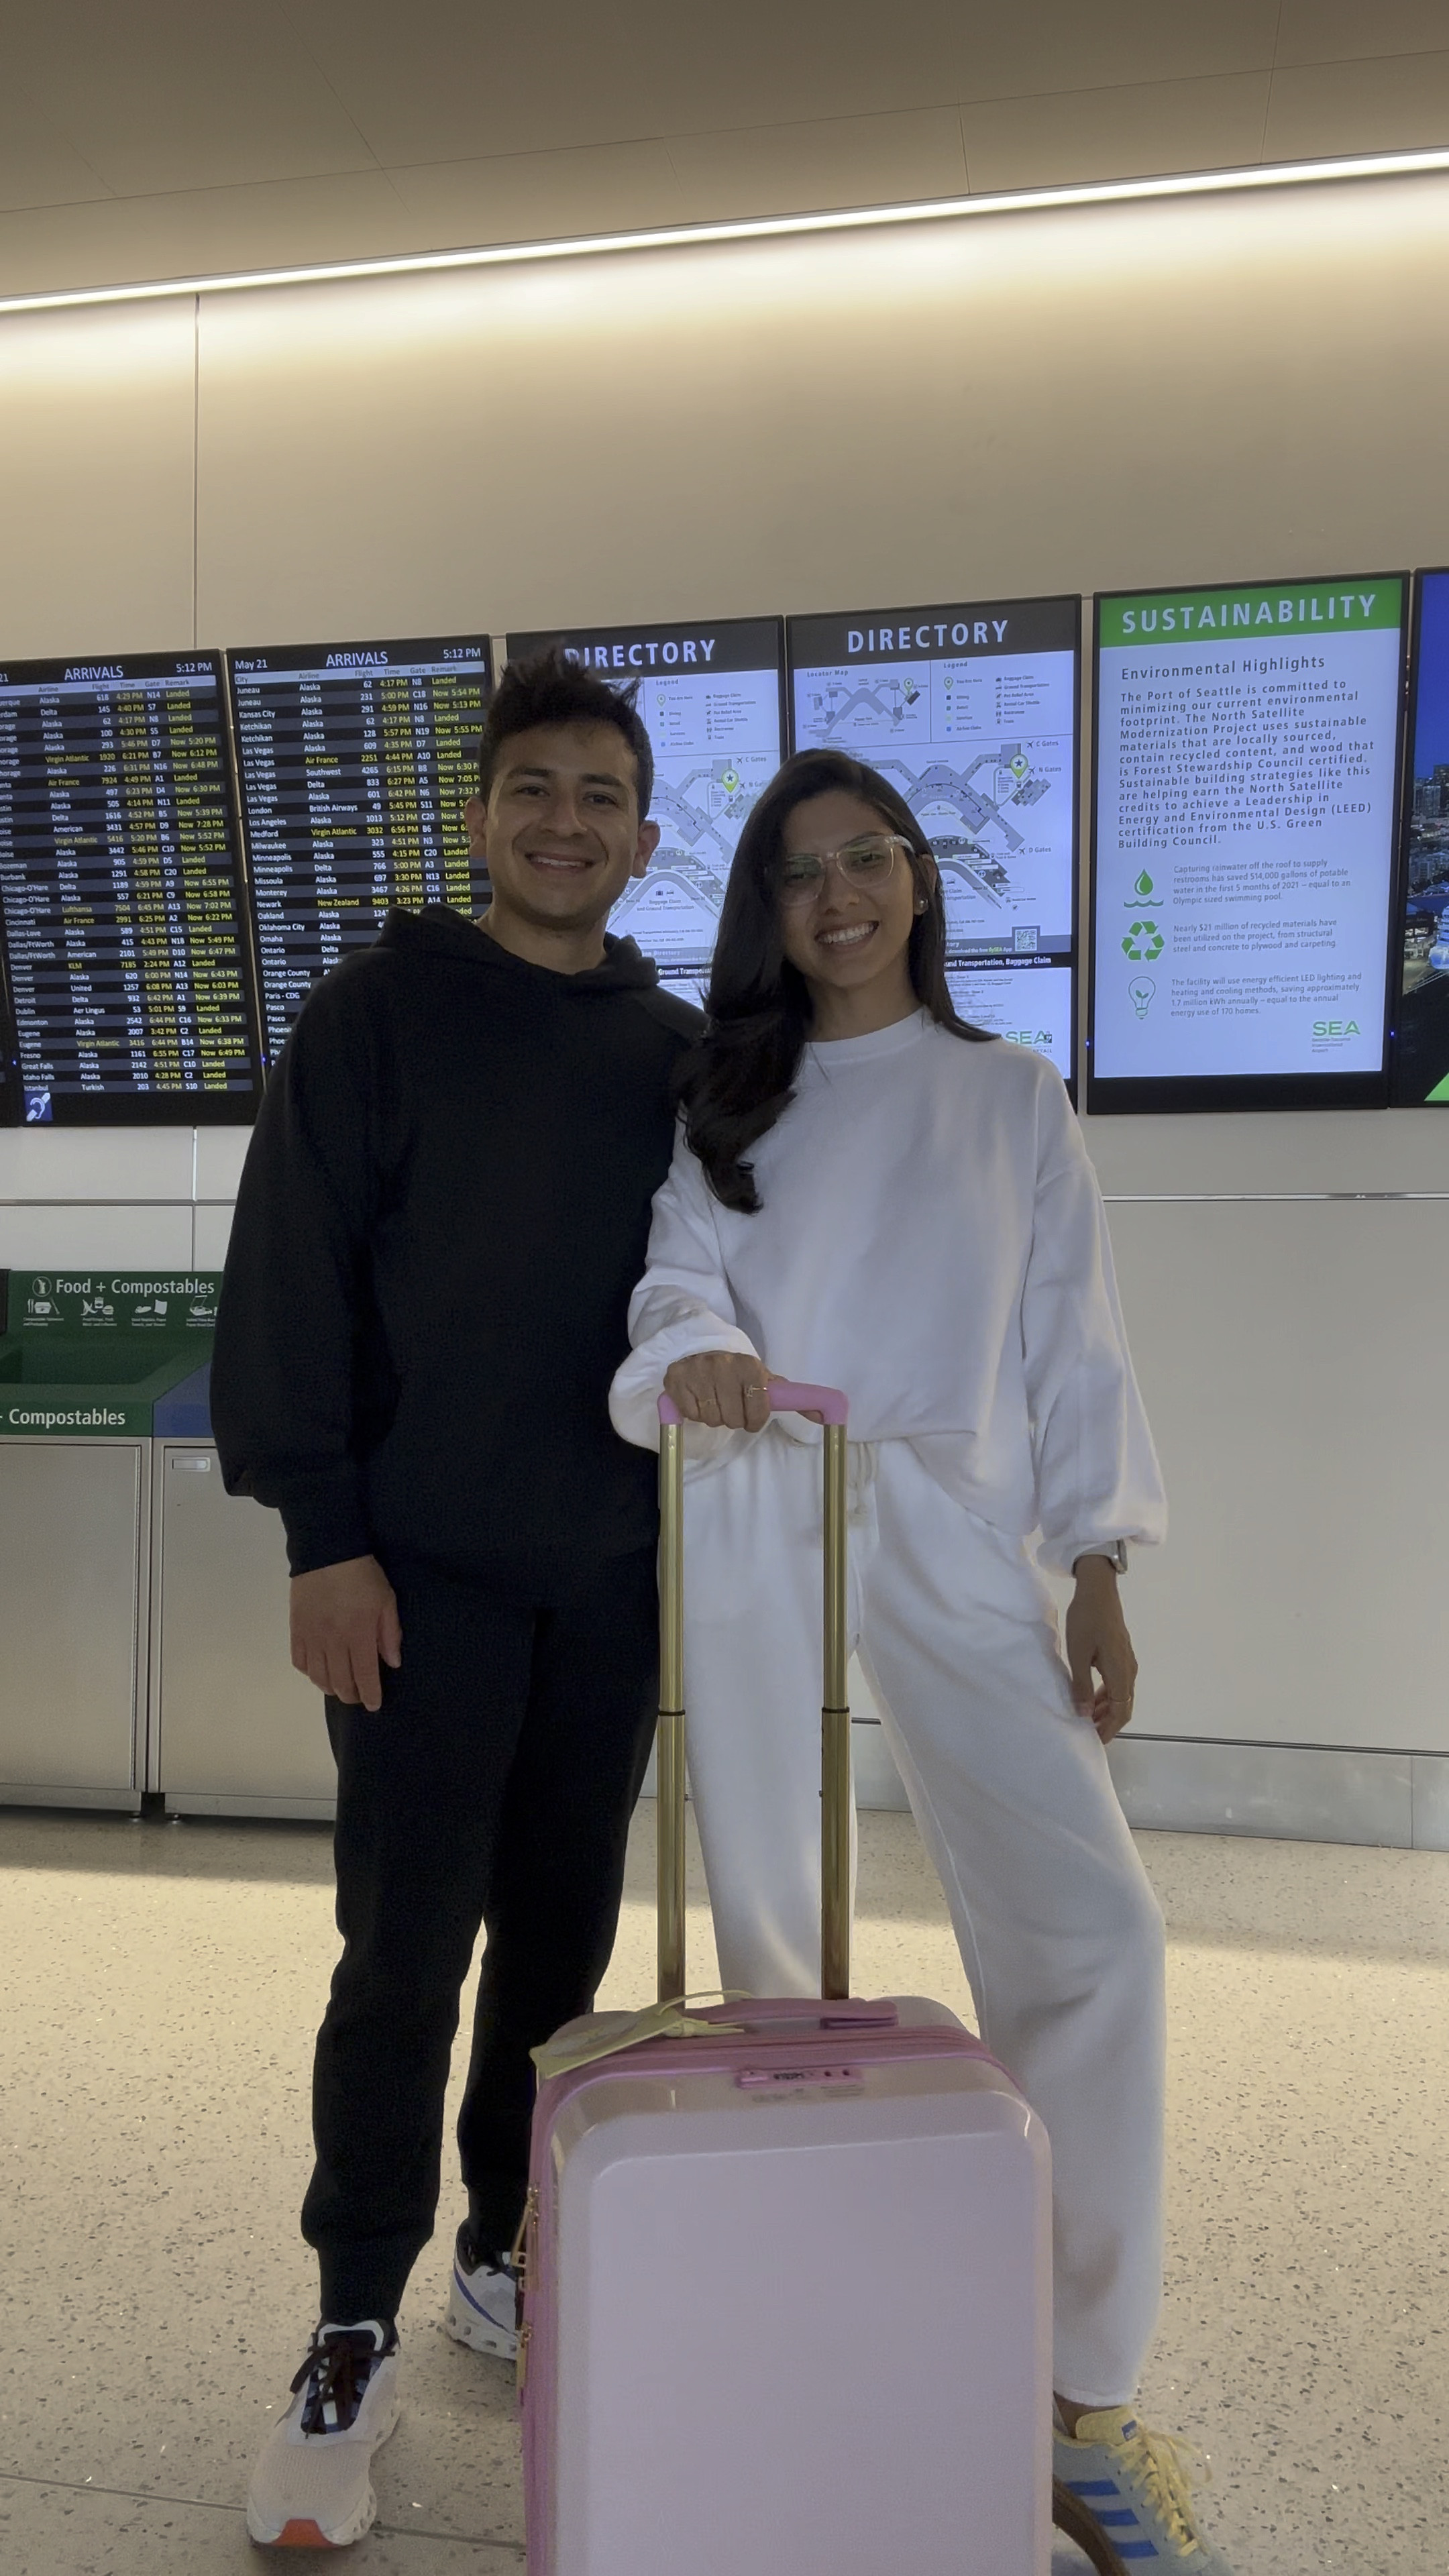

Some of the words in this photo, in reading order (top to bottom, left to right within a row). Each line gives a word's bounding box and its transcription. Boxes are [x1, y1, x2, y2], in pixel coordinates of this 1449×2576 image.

[1122, 594, 1376, 633] SUSTAINABILITY
[848, 620, 1009, 653] DIRECTORY
[235, 660, 254, 670] May
[256, 659, 267, 668] 21
[326, 651, 388, 667] ARRIVALS
[443, 648, 463, 659] 5:12
[466, 647, 480, 657] PM
[565, 639, 715, 668] DIRECTORY
[64, 665, 123, 680] ARRIVALS
[176, 662, 195, 673] 5:12
[197, 661, 212, 671] PM
[835, 669, 849, 677] Map
[944, 661, 968, 669] Legend
[1122, 660, 1235, 680] Environmental
[1242, 655, 1324, 674] Highlights
[234, 675, 248, 684] City
[354, 669, 373, 678] Flight
[1120, 692, 1141, 702] The
[1147, 691, 1173, 700] Port
[1178, 688, 1190, 698] of
[1196, 685, 1241, 697] Seattle
[1247, 684, 1256, 694] is
[1262, 680, 1328, 693] committed
[1334, 680, 1346, 688] to
[262, 710, 275, 718] City
[382, 703, 396, 712] 4:59
[398, 703, 409, 711] PM
[414, 702, 427, 710] N16
[433, 702, 448, 710] Now
[453, 700, 468, 708] 5:13
[1120, 702, 1186, 714] minimizing
[1191, 702, 1212, 710] our
[1216, 698, 1261, 708] current
[1267, 690, 1358, 705] environmental
[1120, 715, 1179, 727] footprint.
[1185, 713, 1205, 722] The
[1212, 710, 1245, 721] North
[1251, 707, 1304, 718] Satellite
[1120, 726, 1208, 739] Modernization
[1214, 722, 1256, 735] Project
[1263, 722, 1288, 731] uses
[1294, 716, 1366, 729] sustainable
[1120, 739, 1176, 751] materials
[1182, 738, 1206, 748] that
[1212, 738, 1231, 746] are
[1236, 733, 1277, 745] locally
[1283, 730, 1335, 742] sourced,
[254, 759, 274, 767] Vegas
[401, 752, 413, 761] PM
[417, 751, 430, 759] A10
[437, 750, 462, 759] Landed
[1120, 753, 1164, 763] contain
[1170, 749, 1220, 761] recycled
[1226, 747, 1276, 758] content,
[1282, 744, 1304, 754] and
[1309, 741, 1342, 753] wood
[1348, 741, 1373, 751] that
[1120, 767, 1128, 776] is
[1134, 765, 1171, 775] Forest
[1177, 759, 1252, 773] Stewardship
[1258, 756, 1302, 768] Council
[1308, 753, 1366, 765] certified.
[1119, 775, 1189, 788] Sustainable
[1195, 773, 1244, 784] building
[1250, 769, 1313, 781] strategies
[1319, 767, 1341, 777] like
[1346, 765, 1370, 775] this
[1142, 788, 1187, 800] helping
[1193, 788, 1219, 796] earn
[1225, 785, 1244, 794] the
[1249, 782, 1284, 793] North
[1289, 780, 1342, 791] Satellite
[1119, 802, 1159, 812] credits
[1165, 802, 1177, 810] to
[1182, 799, 1228, 809] achieve
[1246, 794, 1312, 806] Leadership
[1318, 792, 1329, 802] in
[1119, 816, 1159, 824] Energy
[1164, 812, 1185, 822] and
[1191, 807, 1279, 821] Environmental
[1285, 805, 1326, 817] Design
[1331, 802, 1371, 815] (LEED)
[1118, 824, 1193, 837] certification
[1199, 822, 1226, 833] from
[1232, 821, 1251, 830] the
[1257, 820, 1281, 829] U.S.
[1286, 818, 1322, 828] Green
[1118, 838, 1167, 848] Building
[1173, 834, 1221, 845] Council.
[1173, 924, 1197, 932] Nearly
[1199, 923, 1212, 931] $21
[1214, 922, 1238, 930] million
[1240, 921, 1249, 930] of
[1250, 920, 1281, 930] recycled
[1282, 919, 1317, 927] materials
[1006, 957, 1032, 967] Baggage
[263, 969, 286, 978] Orange
[287, 969, 309, 977] County
[1170, 1010, 1195, 1018] energy
[1211, 1007, 1219, 1015] of
[1312, 1020, 1360, 1036] SEA
[56, 1278, 91, 1293] Food
[96, 1282, 106, 1293] +
[111, 1278, 215, 1297] Compostables
[9, 1408, 125, 1429] Compostables
